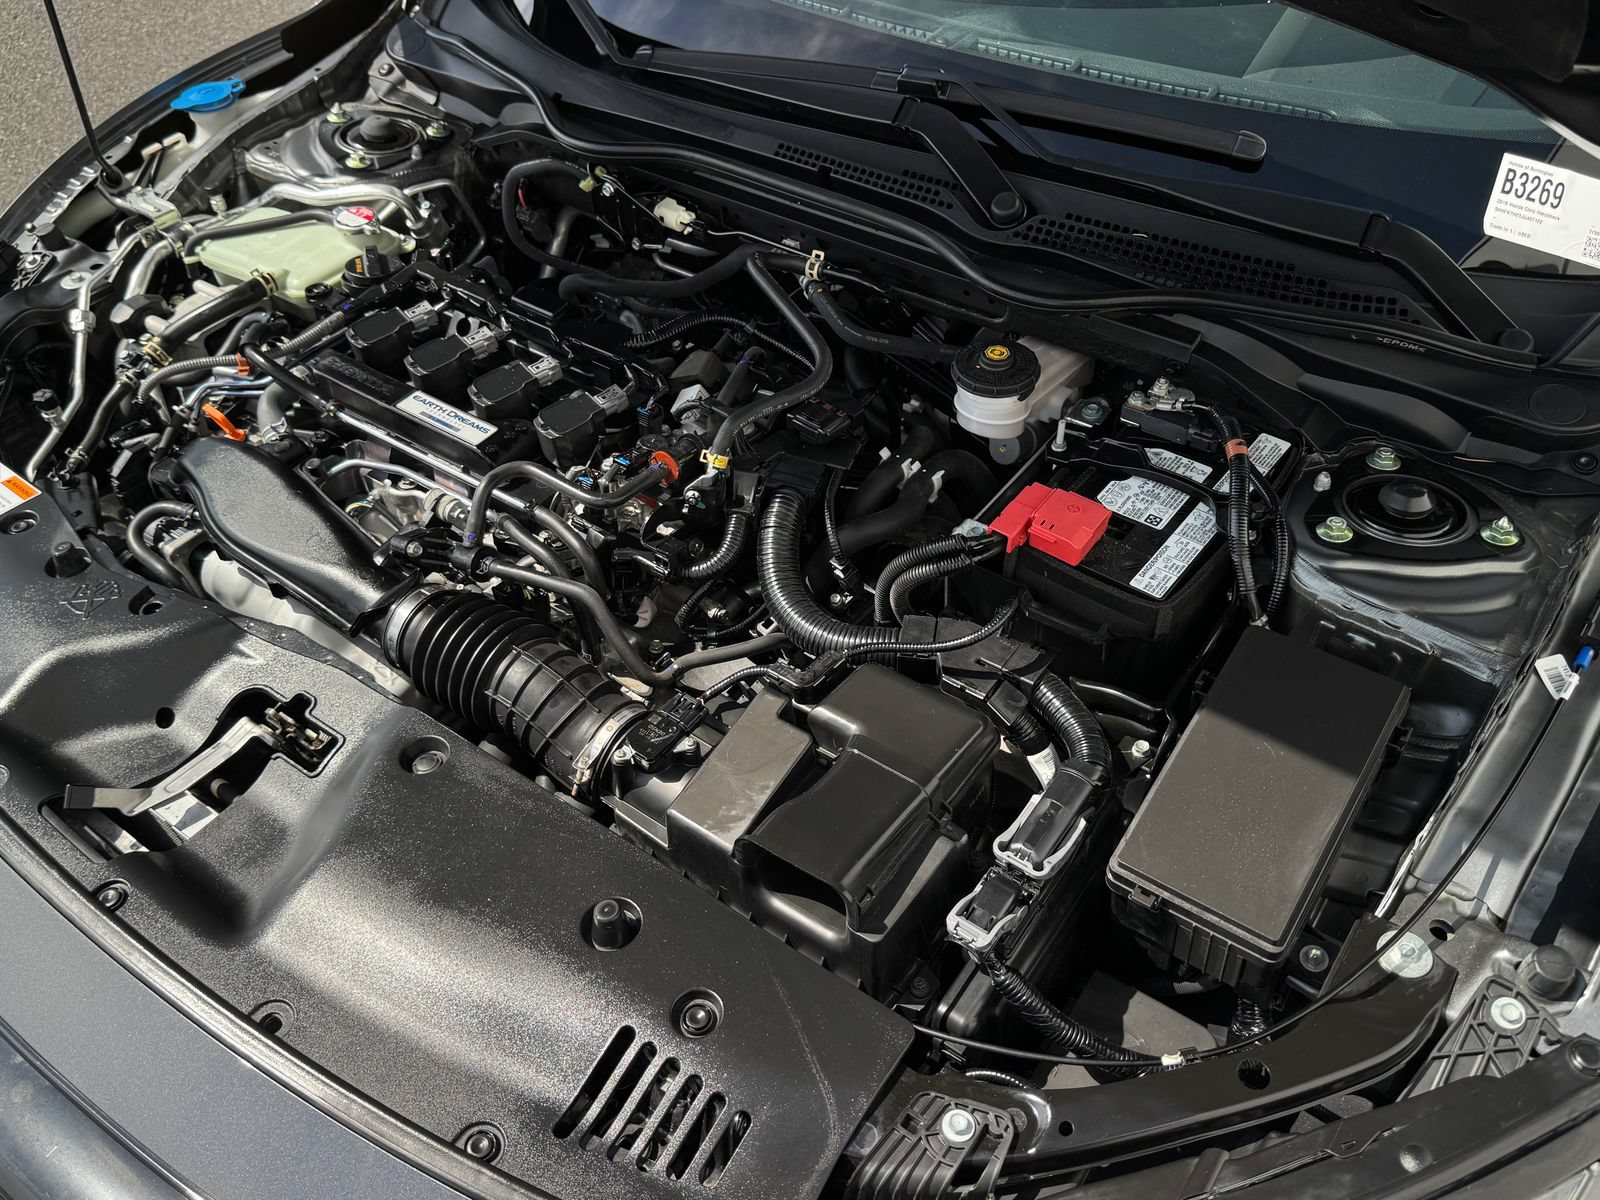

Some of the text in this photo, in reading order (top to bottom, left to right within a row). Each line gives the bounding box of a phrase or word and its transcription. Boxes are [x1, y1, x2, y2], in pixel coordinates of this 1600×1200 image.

[1500, 167, 1565, 209] B3269
[412, 394, 447, 414] EARTH
[447, 409, 491, 434] DREAMS
